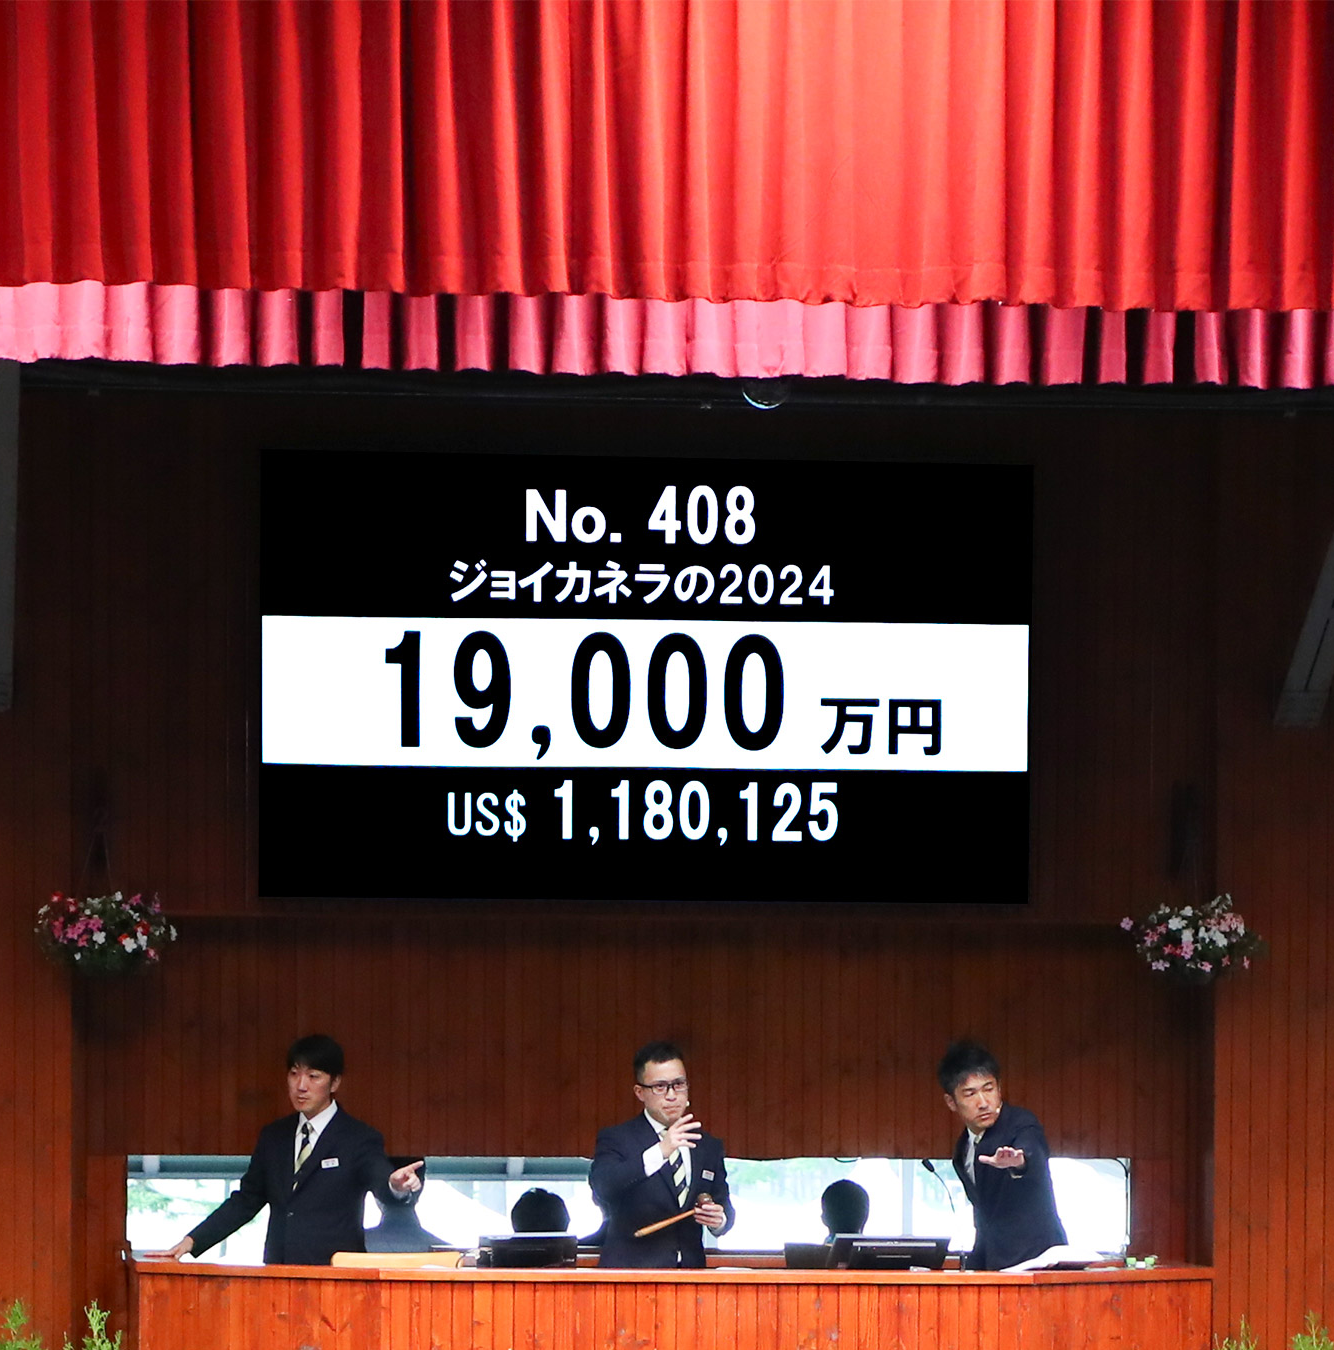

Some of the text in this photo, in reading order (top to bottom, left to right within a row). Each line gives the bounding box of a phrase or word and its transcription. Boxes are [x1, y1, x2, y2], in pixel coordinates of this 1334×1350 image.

[525, 484, 756, 545] No. 408
[449, 559, 835, 605] ジョイカネラの2024
[384, 630, 942, 761] 19,000 万円
[447, 779, 839, 847] US$ 1,180,125
